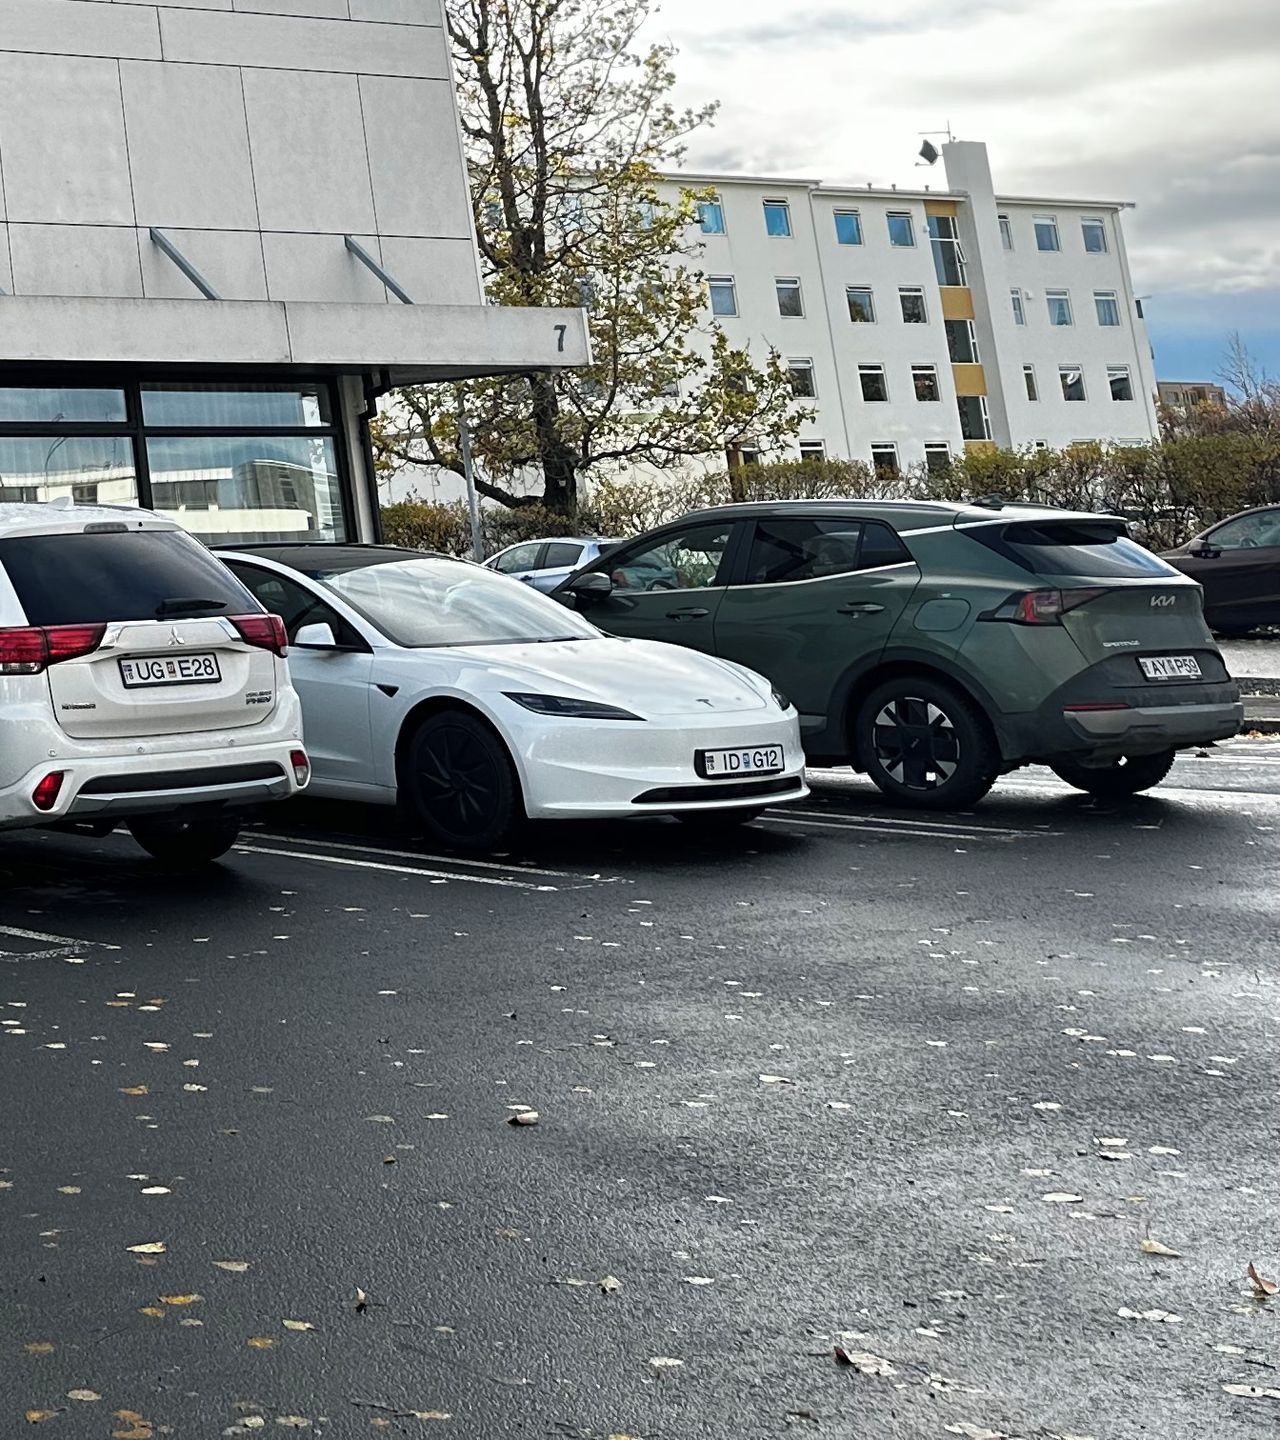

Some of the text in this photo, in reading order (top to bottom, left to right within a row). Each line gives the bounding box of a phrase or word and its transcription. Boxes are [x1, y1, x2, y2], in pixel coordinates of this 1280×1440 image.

[553, 324, 568, 353] 7
[136, 661, 166, 680] UG
[177, 657, 215, 678] E28
[723, 753, 741, 771] ID
[753, 749, 779, 768] G12
